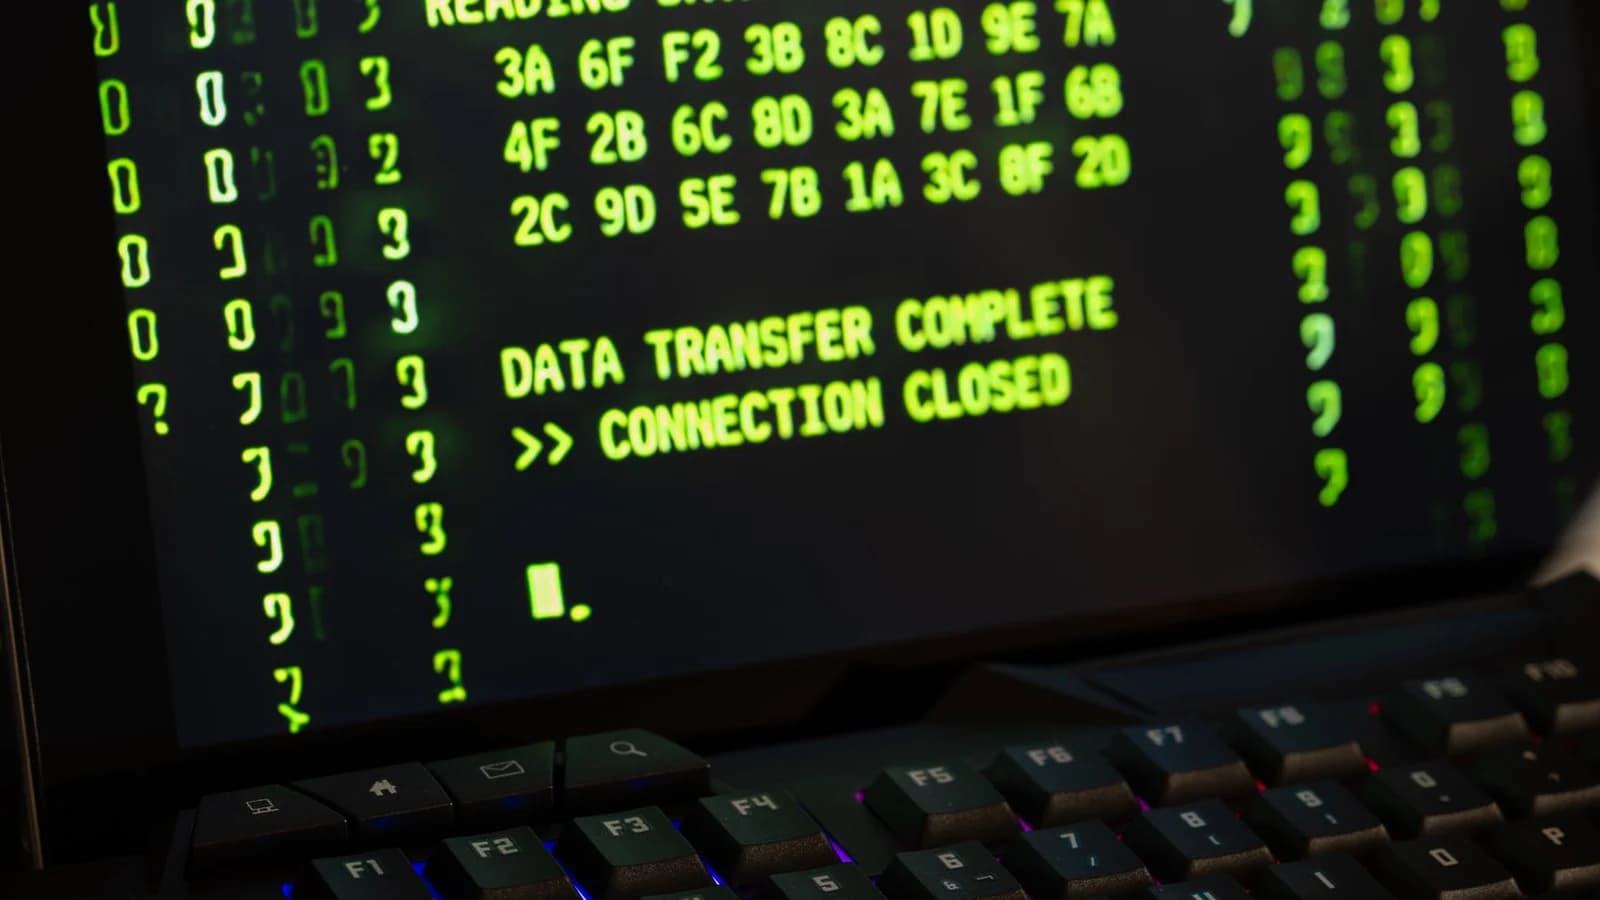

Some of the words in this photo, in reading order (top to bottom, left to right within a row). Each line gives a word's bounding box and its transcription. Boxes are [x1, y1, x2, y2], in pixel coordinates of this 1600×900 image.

[494, 44, 555, 98] 3A
[578, 36, 635, 90] 6F
[662, 28, 723, 82] F2
[744, 22, 805, 75] 3B
[824, 14, 884, 68] 8C
[907, 8, 963, 61] 1D
[981, 0, 1040, 55] 9E
[1055, 0, 1116, 47] 7A
[504, 117, 560, 172] 4F
[586, 110, 648, 164] 2B
[671, 101, 732, 156] 6C
[751, 94, 813, 148] 8D
[832, 88, 895, 141] 3A
[911, 78, 971, 133] 7E
[991, 70, 1045, 127] 1F
[510, 192, 572, 246] 2C
[594, 184, 656, 237] 9D
[760, 166, 822, 219] 7B
[843, 158, 903, 212] 1A
[921, 149, 981, 204] 3C
[500, 336, 625, 398] DATA
[644, 305, 875, 380] TRANSFER
[895, 276, 1117, 352] COMPLETE
[599, 377, 884, 460] CONNECTION
[903, 353, 1071, 422] CLOSED
[1145, 726, 1184, 747] F7
[1028, 746, 1073, 767] F6
[908, 767, 953, 787] F5
[731, 795, 777, 816] F4
[603, 816, 649, 837] F3
[471, 837, 519, 858] F2
[1060, 832, 1079, 849] 7
[344, 859, 384, 879] F1
[937, 853, 964, 870] 6
[812, 874, 839, 892] 5
